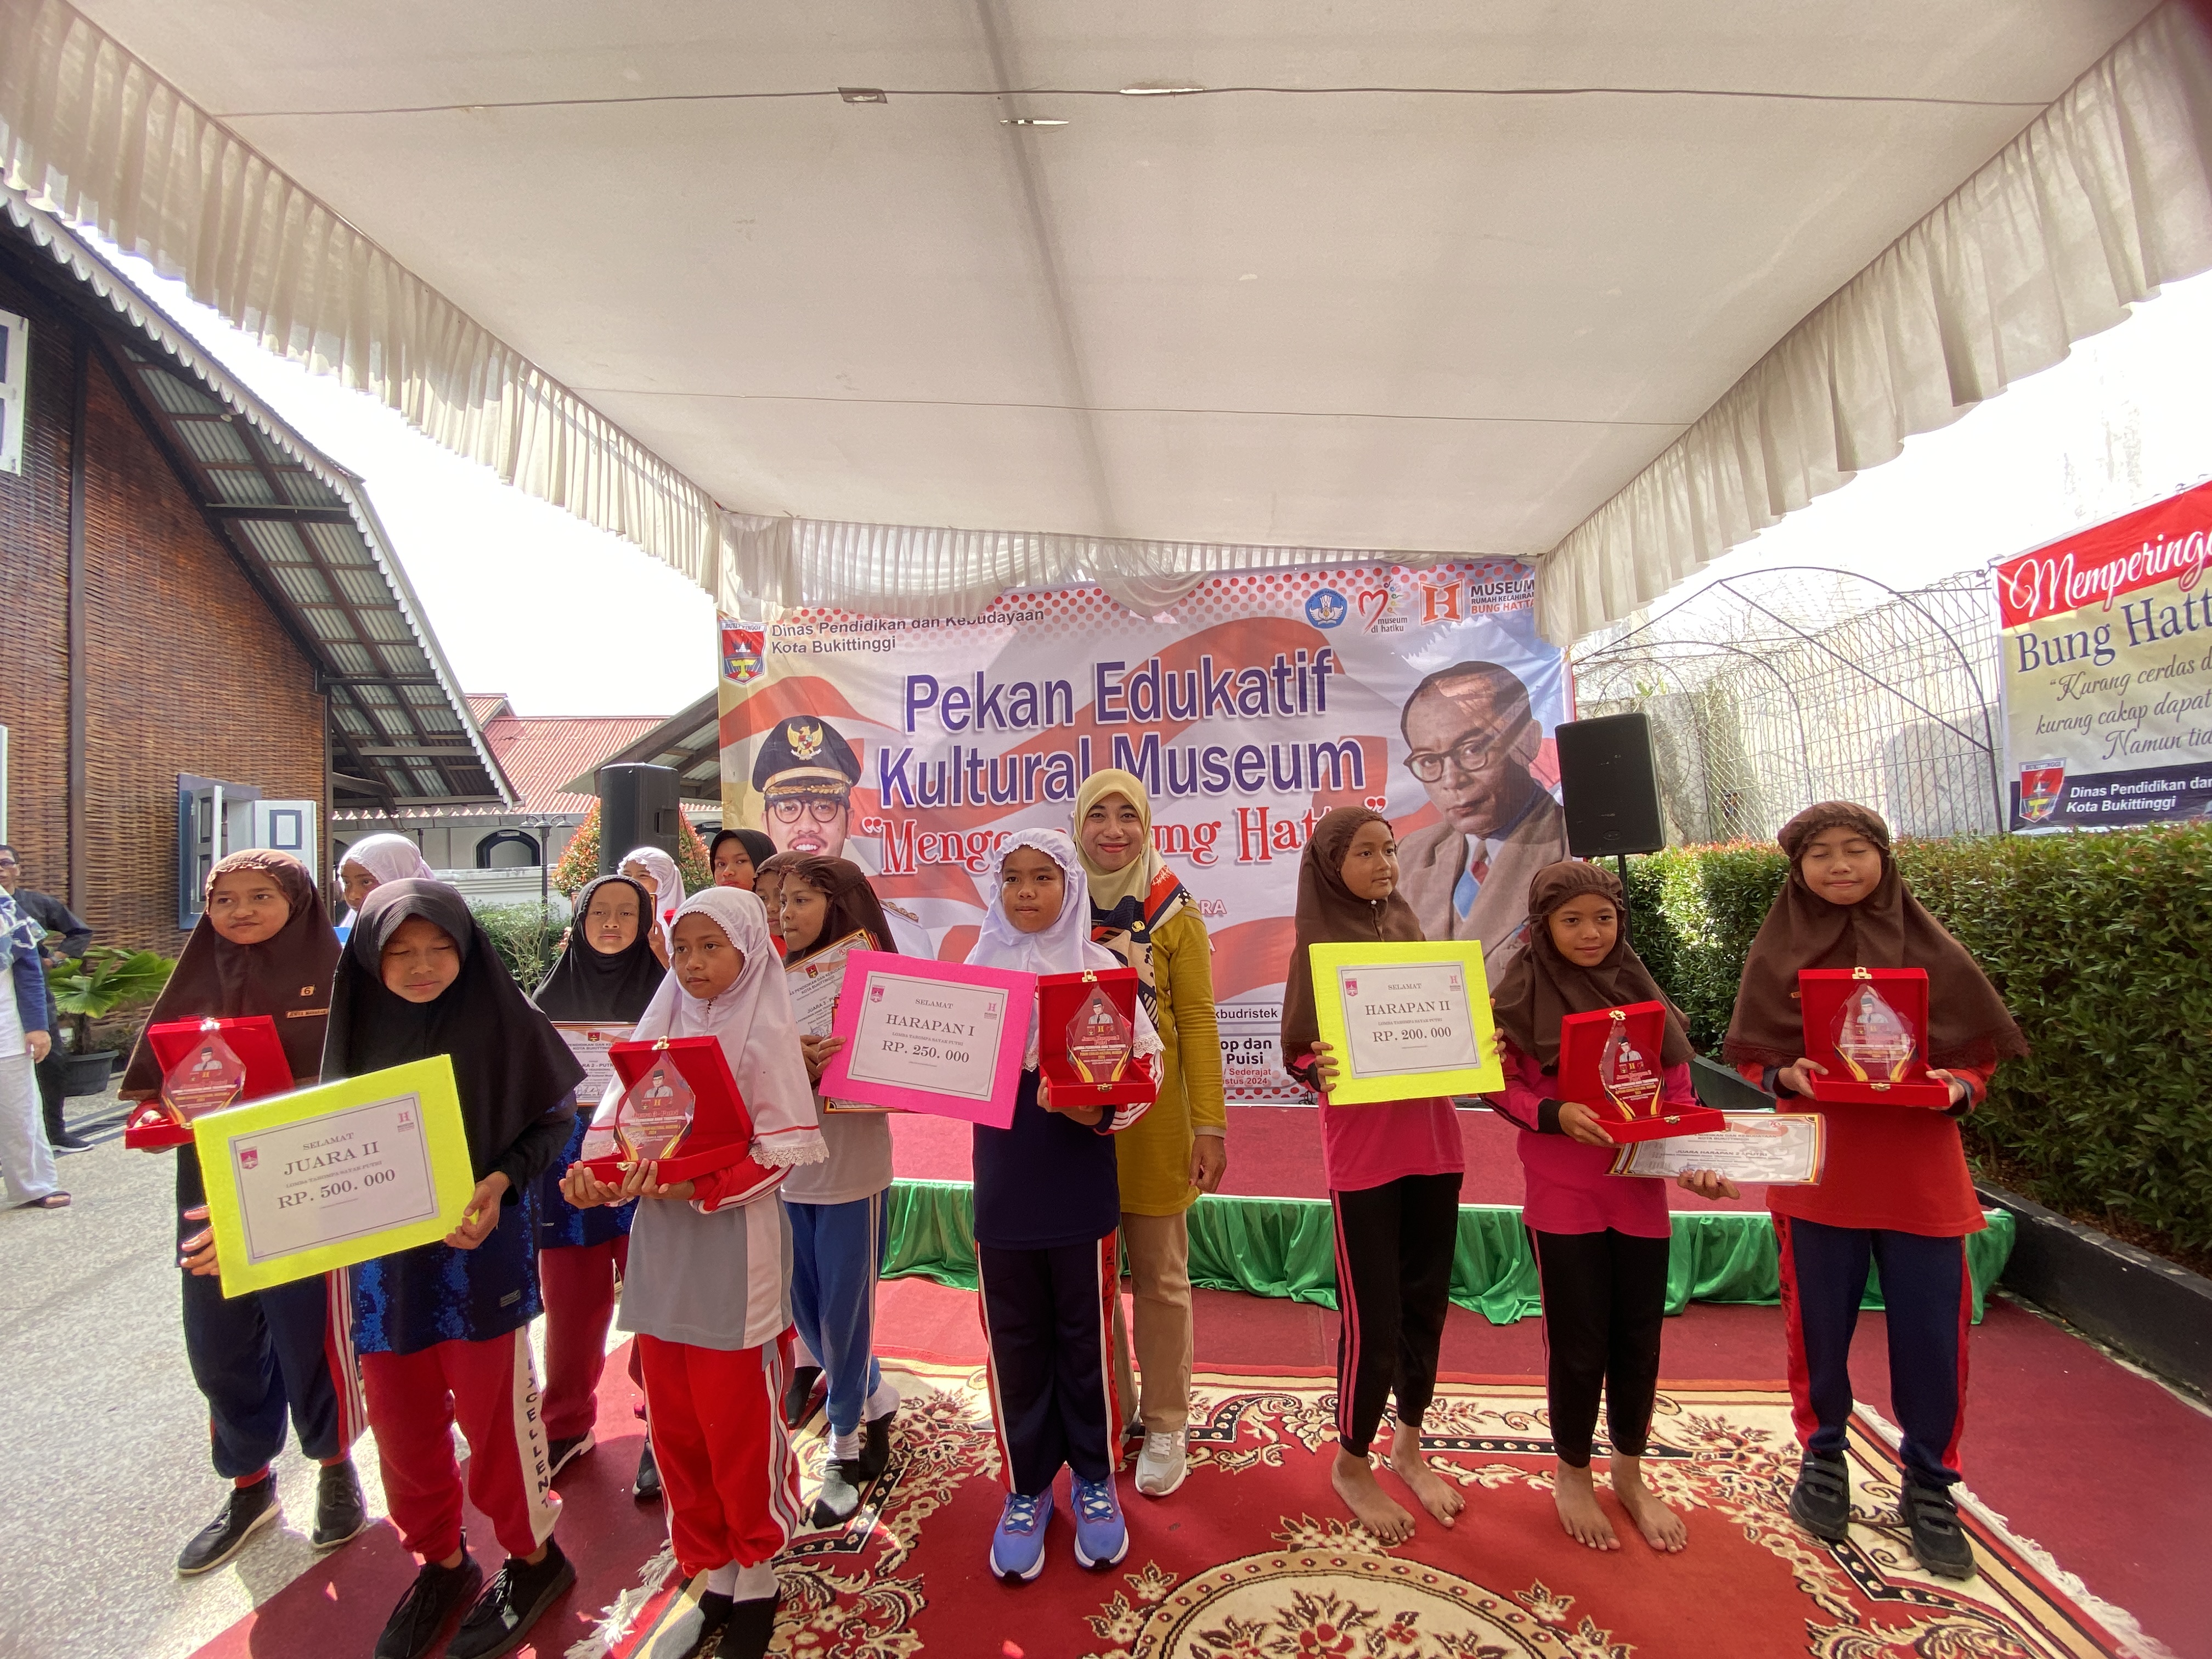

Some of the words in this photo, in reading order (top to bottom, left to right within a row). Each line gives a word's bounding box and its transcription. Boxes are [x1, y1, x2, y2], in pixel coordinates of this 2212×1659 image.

[1471, 579, 1534, 597] MUSEUM
[1471, 596, 1497, 605] RUMAH
[1471, 603, 1500, 614] BUNG
[772, 623, 814, 637] Dinas
[819, 618, 906, 635] Pendidikan
[911, 618, 940, 629] dan
[1372, 625, 1378, 633] di
[1378, 617, 1408, 625] museum
[2015, 623, 2115, 673] Bung
[2120, 588, 2212, 647] Hatt
[772, 641, 807, 654] Kota
[812, 635, 896, 653] Bukittinggi
[2137, 654, 2195, 685] cerdas
[905, 670, 1073, 732] Pekan
[1096, 648, 1333, 721] Edukatif
[2035, 714, 2094, 736] kurang
[2097, 700, 2148, 729] cakap
[2153, 689, 2212, 723] dapat
[2102, 727, 2182, 760] Namun
[879, 737, 1090, 807] Kultural
[1113, 733, 1365, 795] Museum
[2070, 786, 2107, 799] Dinas
[2111, 779, 2186, 796] Pendidikan
[2066, 801, 2098, 813] Kota
[2101, 795, 2177, 811] Bukittinggi
[915, 998, 953, 1009] SELAMAT
[1364, 1001, 1435, 1015] HARAPAN
[1438, 1000, 1451, 1011] II
[885, 1013, 965, 1035] HARAPAN
[967, 1025, 976, 1036] I
[1372, 1030, 1398, 1042] RP.
[1401, 1028, 1427, 1040] 200.
[1430, 1026, 1452, 1038] 000
[881, 1040, 908, 1053] RP.
[912, 1045, 940, 1059] 250.
[945, 1049, 970, 1063] 000
[1243, 1037, 1272, 1050] dan
[1227, 1052, 1264, 1065] Puisi
[1229, 1068, 1271, 1077] Sederajat
[303, 1132, 354, 1150] SELAMAT
[284, 1147, 357, 1176] JUARA
[362, 1141, 381, 1156] II
[277, 1190, 314, 1209] RP.
[320, 1180, 358, 1198] 500.
[364, 1169, 396, 1187] 000
